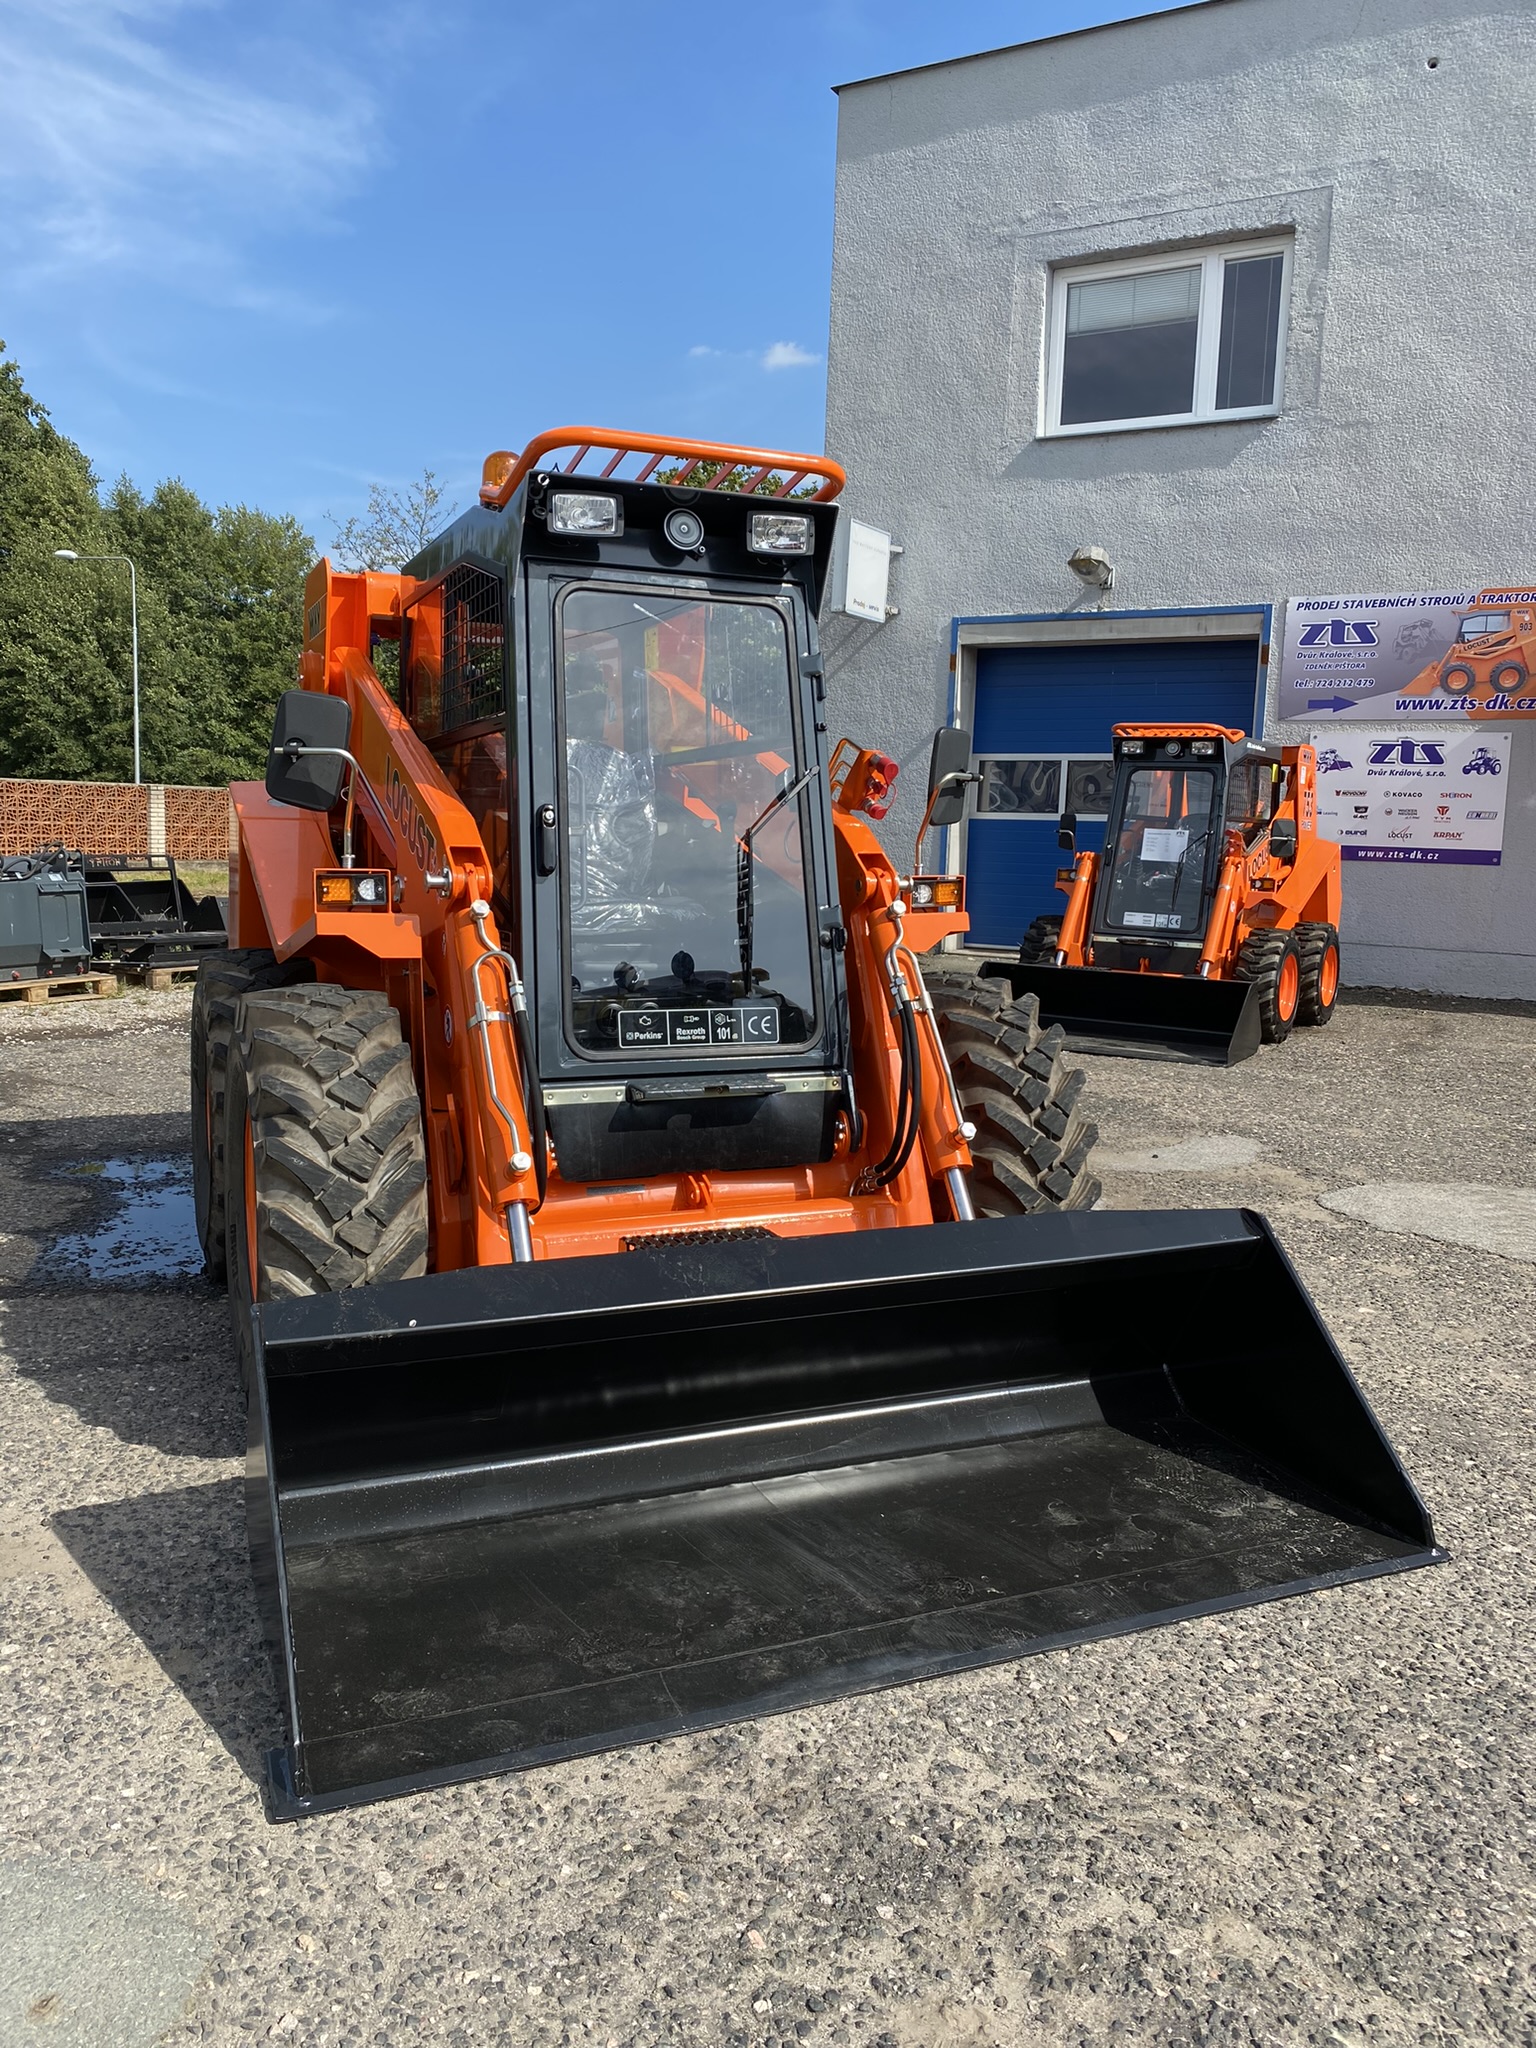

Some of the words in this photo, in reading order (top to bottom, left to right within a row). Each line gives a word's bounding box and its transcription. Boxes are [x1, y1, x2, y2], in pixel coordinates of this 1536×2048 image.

[1296, 601, 1340, 611] PRODEJ
[1342, 596, 1416, 610] STAVEBNÍCH
[1467, 594, 1476, 605] A
[1519, 623, 1533, 631] 903
[1463, 638, 1491, 652] LOCUST
[1296, 651, 1317, 659] Dvůr
[1304, 662, 1332, 670] ZDENĚK
[1334, 661, 1366, 670] PIŠTORA
[1295, 679, 1314, 688] tel.:
[1316, 680, 1333, 688] 724
[1356, 679, 1375, 687] 479
[1395, 694, 1536, 710] www.zts-dk.cz
[1367, 768, 1387, 776] Dvůr
[385, 753, 437, 870] LOCUST
[1433, 831, 1463, 839] KRPAN
[1358, 850, 1440, 860] www.zts-dk.cz
[748, 1015, 772, 1035] CE
[634, 1032, 662, 1040] Perkins
[676, 1027, 706, 1036] Rexroth
[716, 1027, 731, 1040] 101
